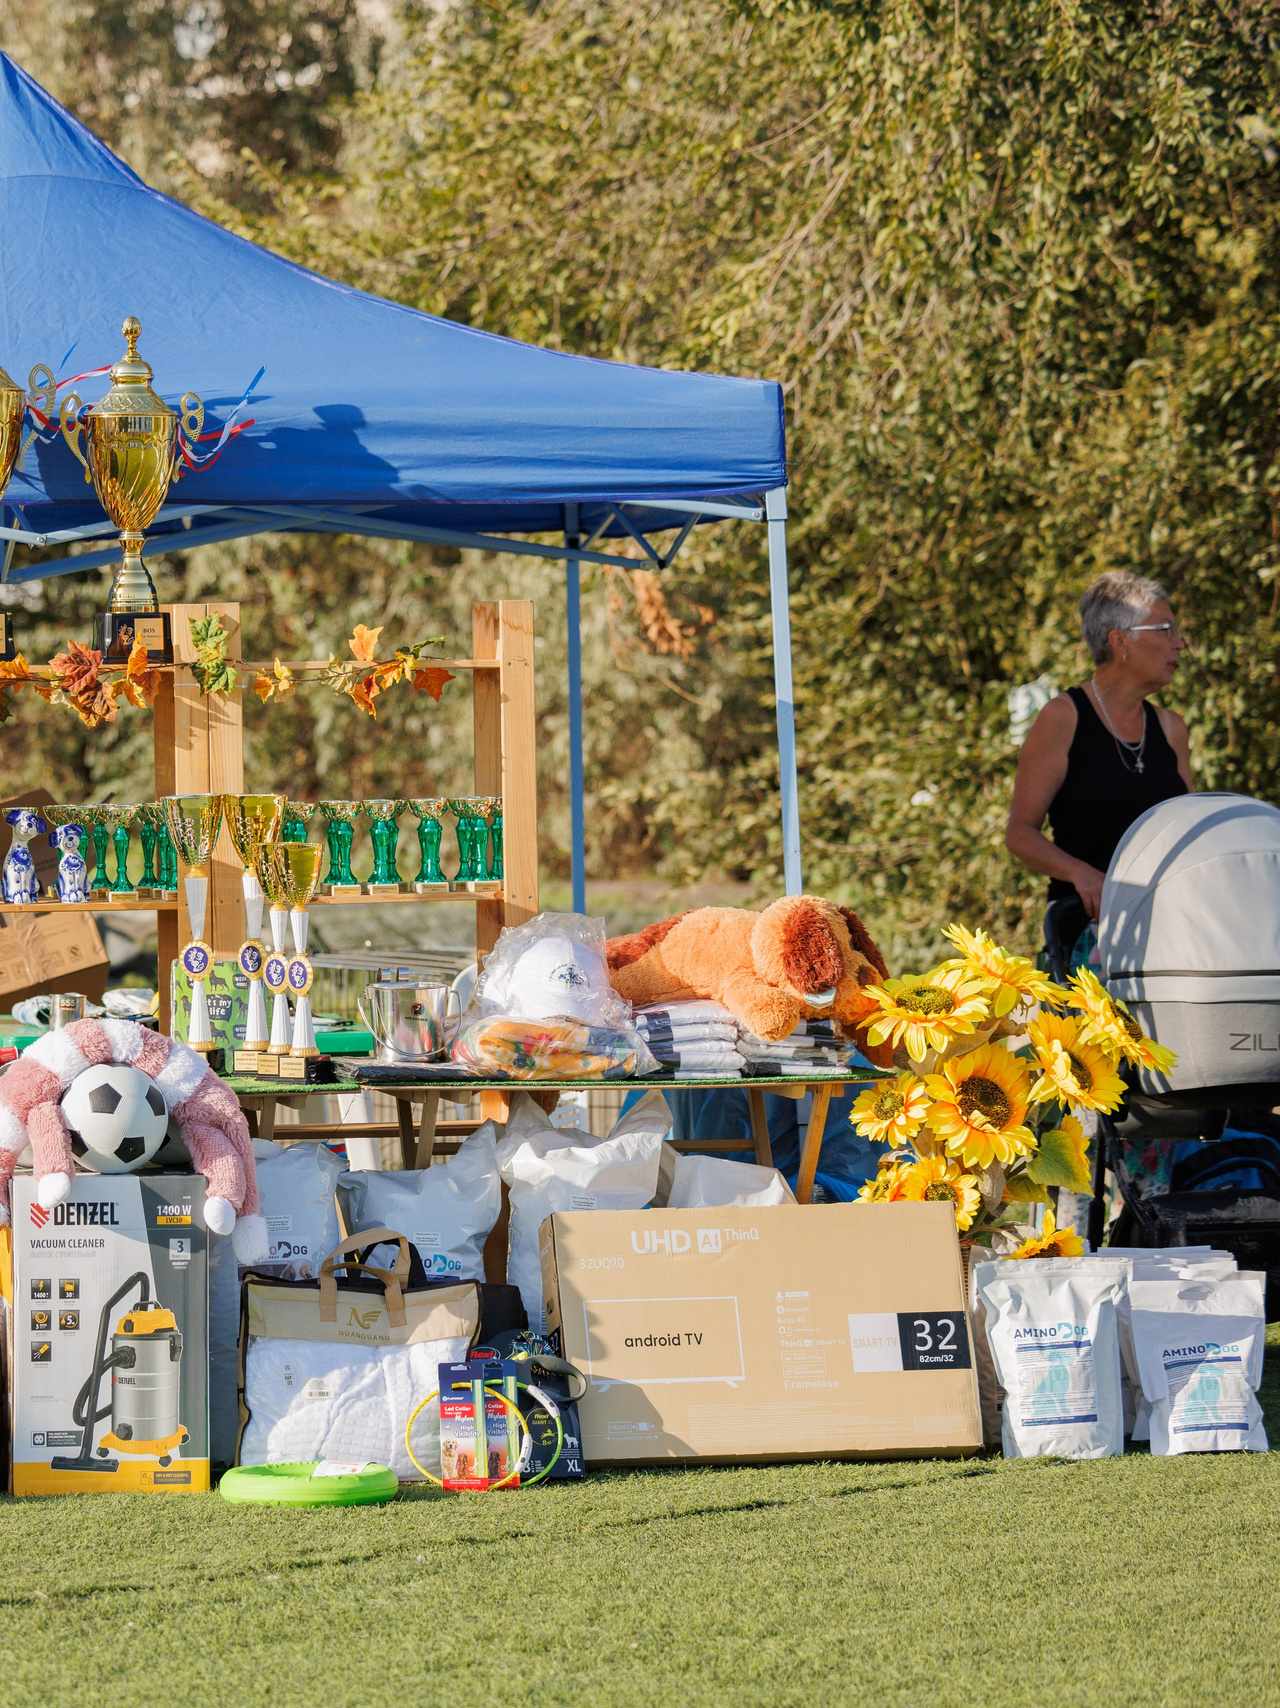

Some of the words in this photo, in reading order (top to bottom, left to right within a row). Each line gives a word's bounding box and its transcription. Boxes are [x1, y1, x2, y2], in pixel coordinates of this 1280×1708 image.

[60, 999, 75, 1007] 555
[220, 999, 232, 1010] my
[210, 1007, 226, 1016] life
[1229, 1033, 1280, 1051] ZIL
[54, 1202, 120, 1226] DENZEL
[157, 1205, 180, 1216] 1400
[182, 1205, 192, 1215] W
[30, 1239, 66, 1248] VACUUM
[68, 1239, 105, 1248] CLEANER
[177, 1240, 184, 1253] 3
[630, 1230, 692, 1254] UHD
[700, 1234, 720, 1248] AI
[723, 1228, 760, 1241] ThinQ
[30, 1251, 54, 1259] ПЫЛЕСОС
[580, 1257, 625, 1270] 32UQ70
[338, 1330, 390, 1341] NUANGUANG
[624, 1332, 680, 1348] android
[684, 1332, 704, 1346] TV
[913, 1319, 957, 1351] 32
[853, 1337, 883, 1348] SMART
[887, 1337, 898, 1347] TV
[470, 1351, 494, 1359] flexi
[919, 1354, 954, 1363] 82cm/32
[118, 1377, 136, 1385] DENZEL
[784, 1380, 839, 1389] Frameless
[454, 1415, 474, 1423] Nylon
[487, 1412, 507, 1421] Nylon
[568, 1460, 581, 1471] XL
